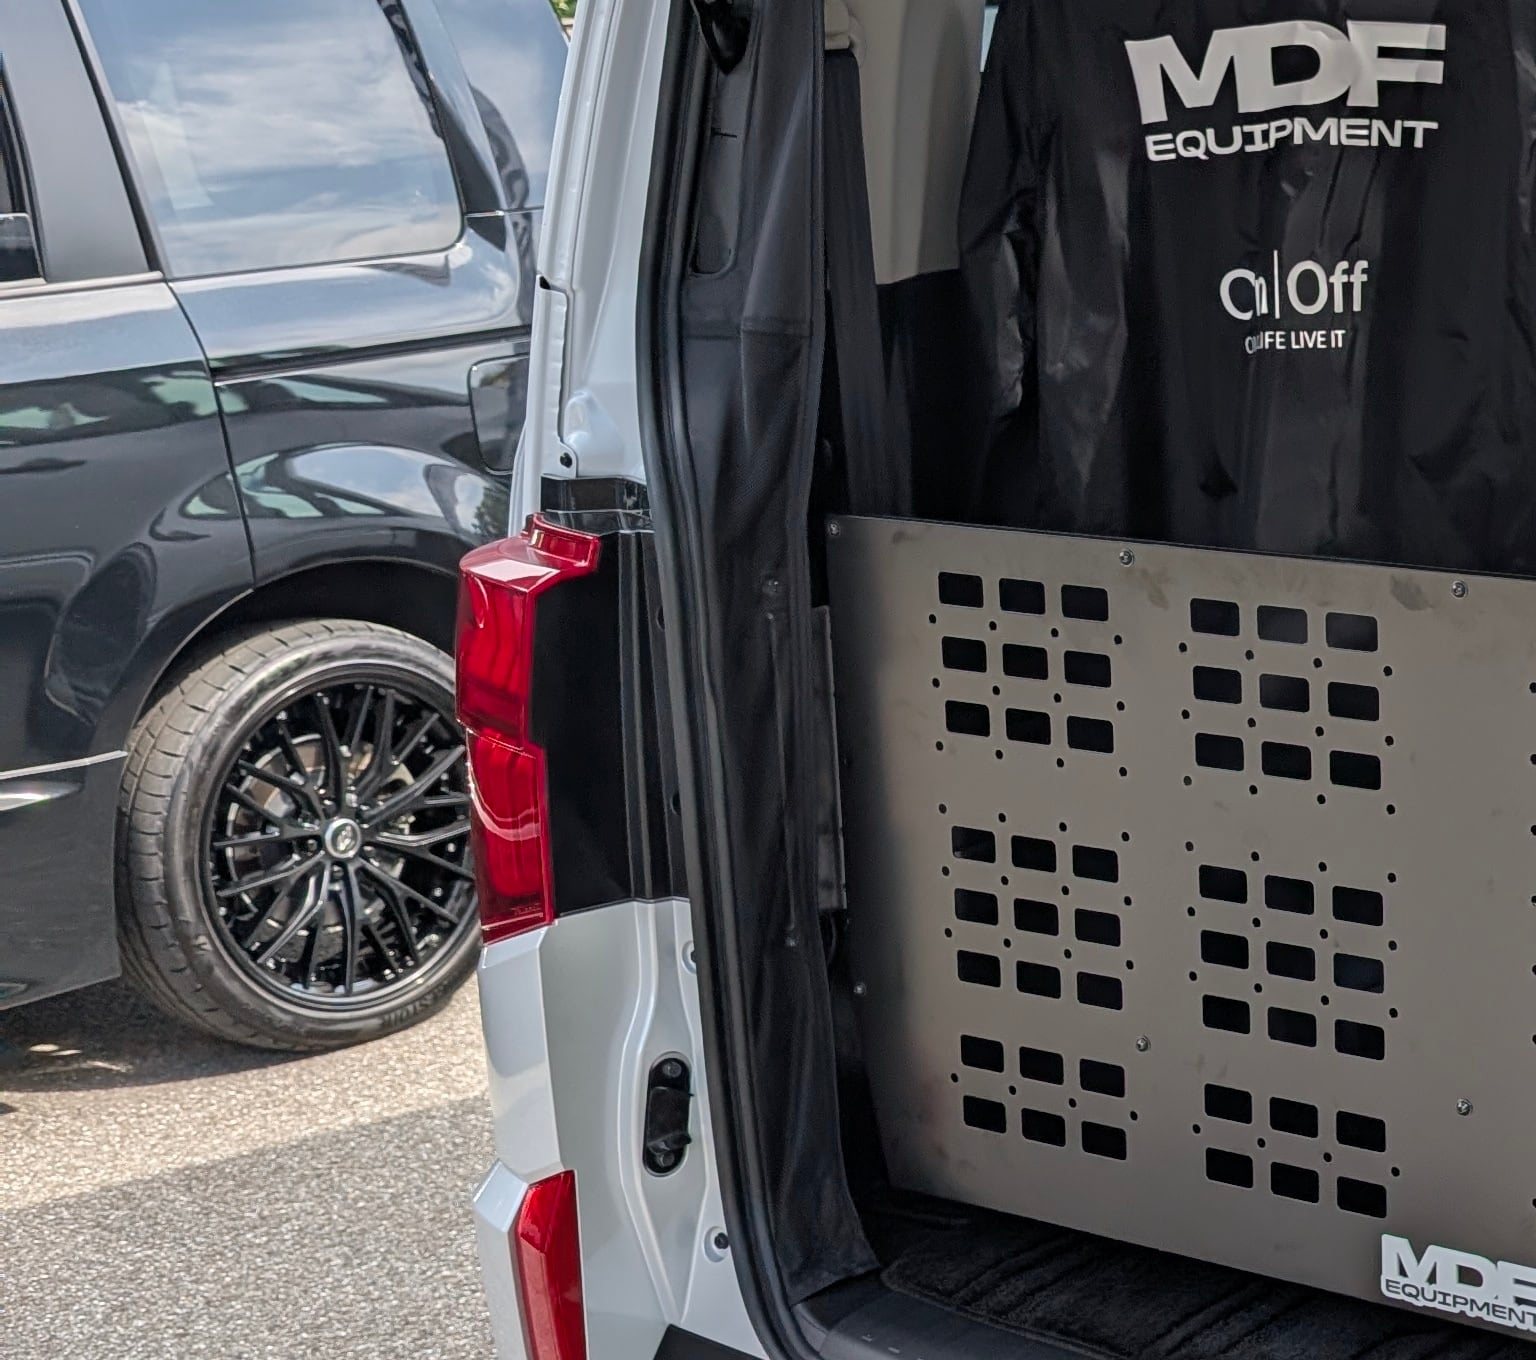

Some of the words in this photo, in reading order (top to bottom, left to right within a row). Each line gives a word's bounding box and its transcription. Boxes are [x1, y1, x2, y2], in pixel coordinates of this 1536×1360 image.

[1124, 20, 1446, 123] MDF
[1144, 117, 1439, 161] EQUIPMENT
[1290, 330, 1327, 349] LIVE
[1330, 329, 1347, 348] IT
